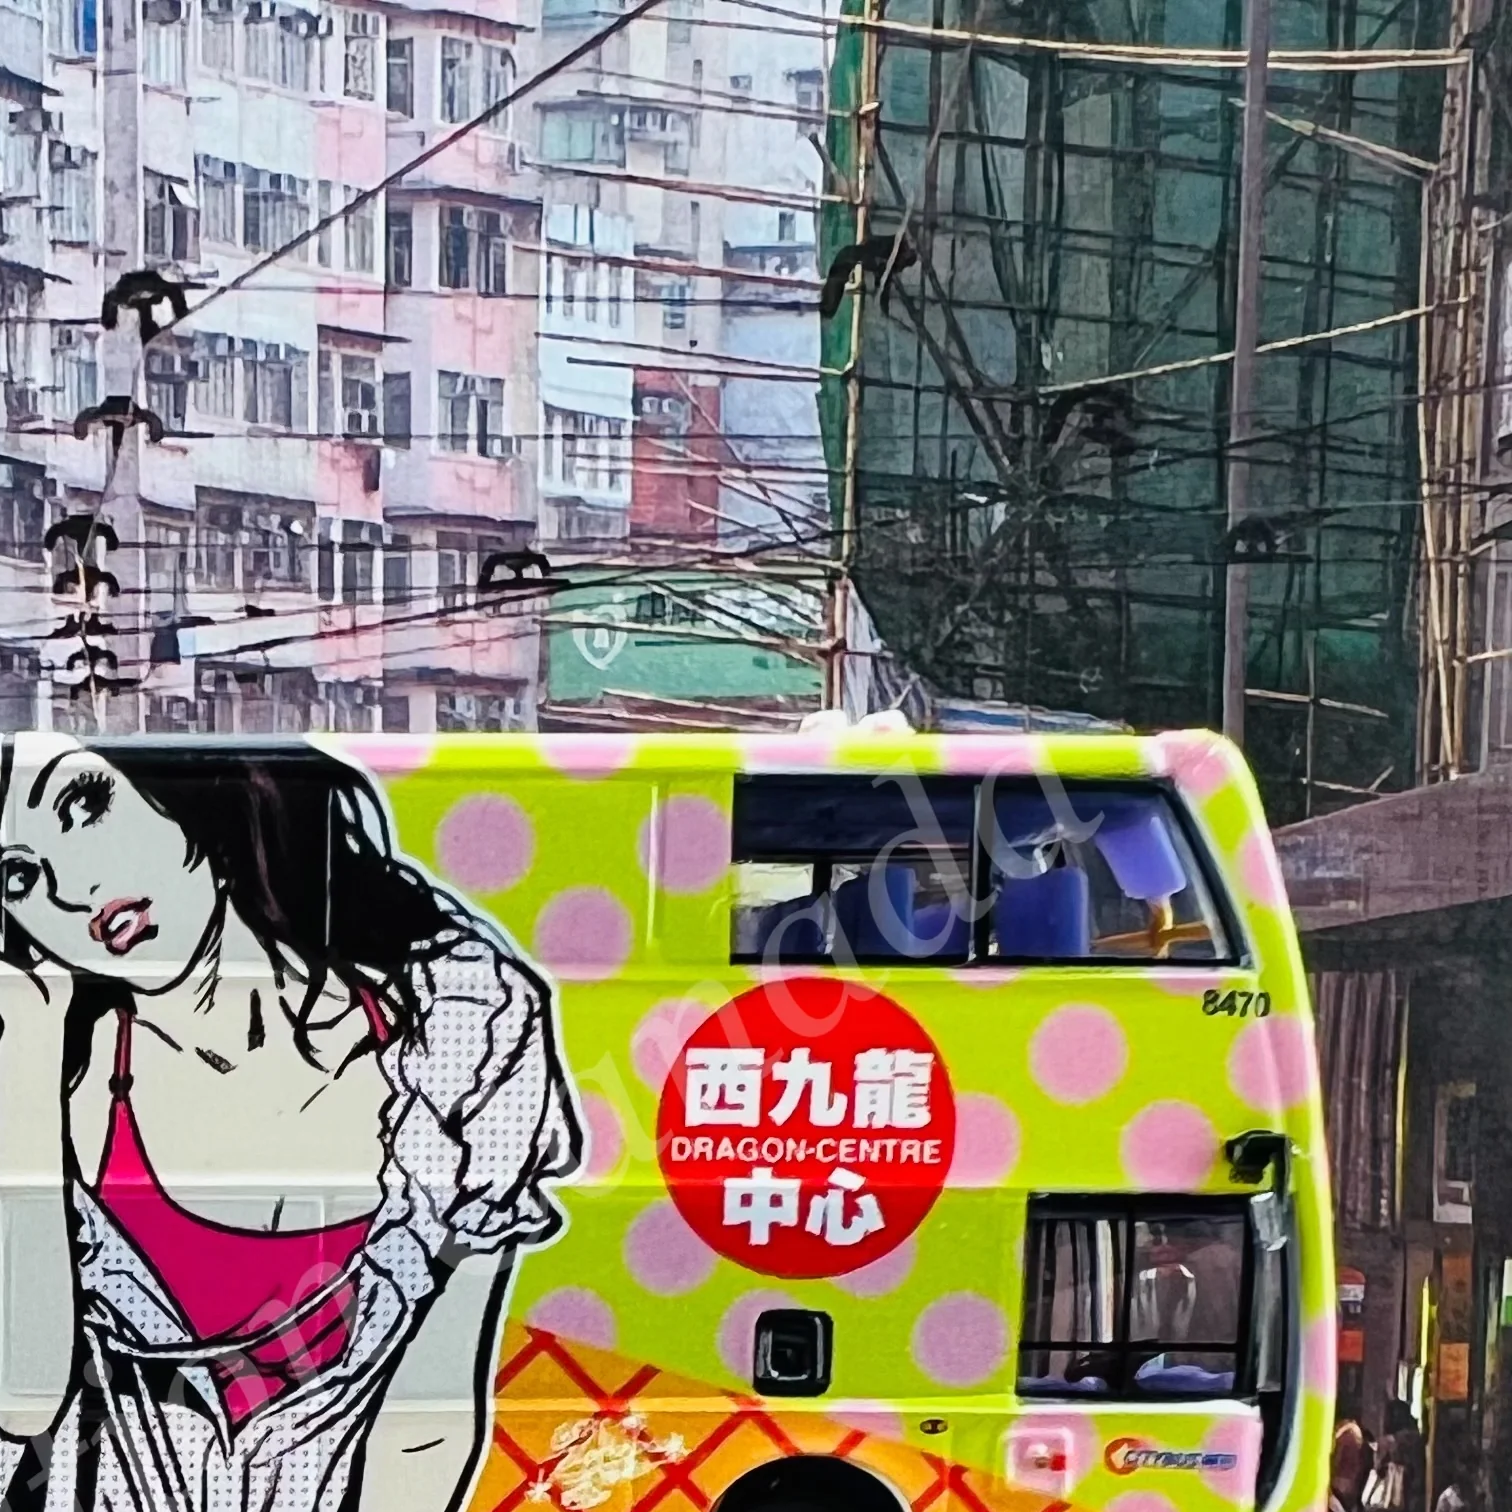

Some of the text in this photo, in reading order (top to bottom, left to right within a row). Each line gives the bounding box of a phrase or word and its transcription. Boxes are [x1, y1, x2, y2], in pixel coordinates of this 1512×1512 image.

[1201, 989, 1271, 1018] 8470
[684, 1047, 935, 1129] 西九龍
[722, 1167, 886, 1246] 中心
